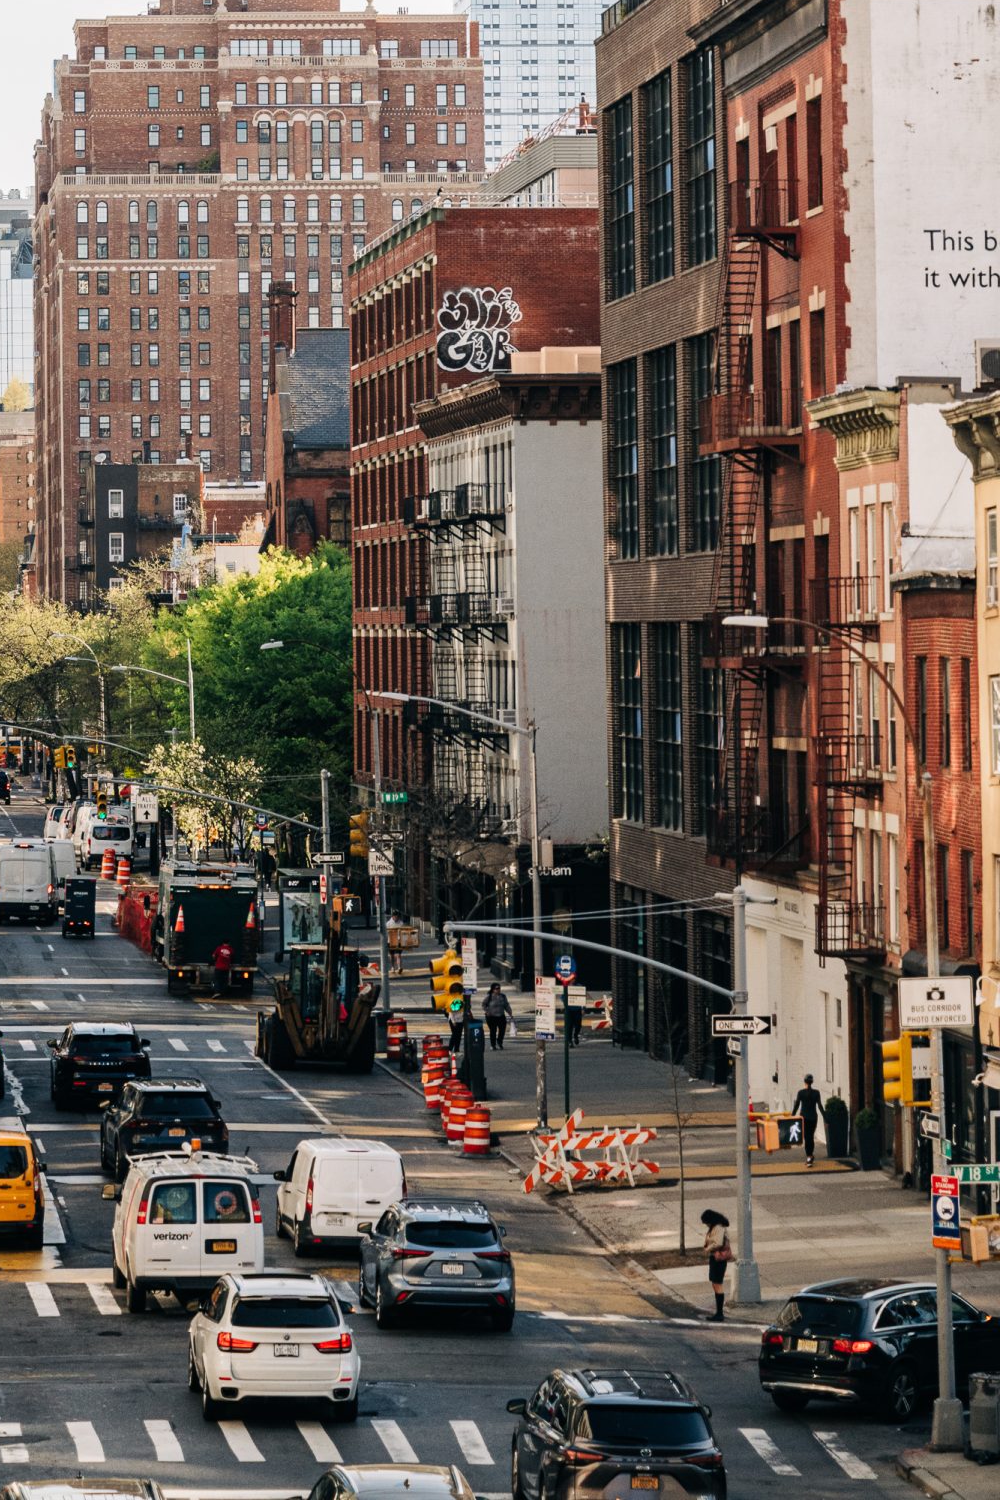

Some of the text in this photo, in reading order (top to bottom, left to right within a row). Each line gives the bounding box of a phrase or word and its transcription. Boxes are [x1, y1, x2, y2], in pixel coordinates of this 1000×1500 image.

[923, 229, 974, 251] This
[925, 267, 941, 288] it
[375, 854, 389, 862] NO
[370, 864, 393, 872] TURNS
[528, 866, 572, 879] gtham
[927, 1004, 962, 1012] CORRIDOR
[719, 1021, 759, 1029] ONE WAY
[474, 1028, 480, 1036] P
[953, 1166, 995, 1181] W 18 ST
[153, 1231, 189, 1240] verizon
